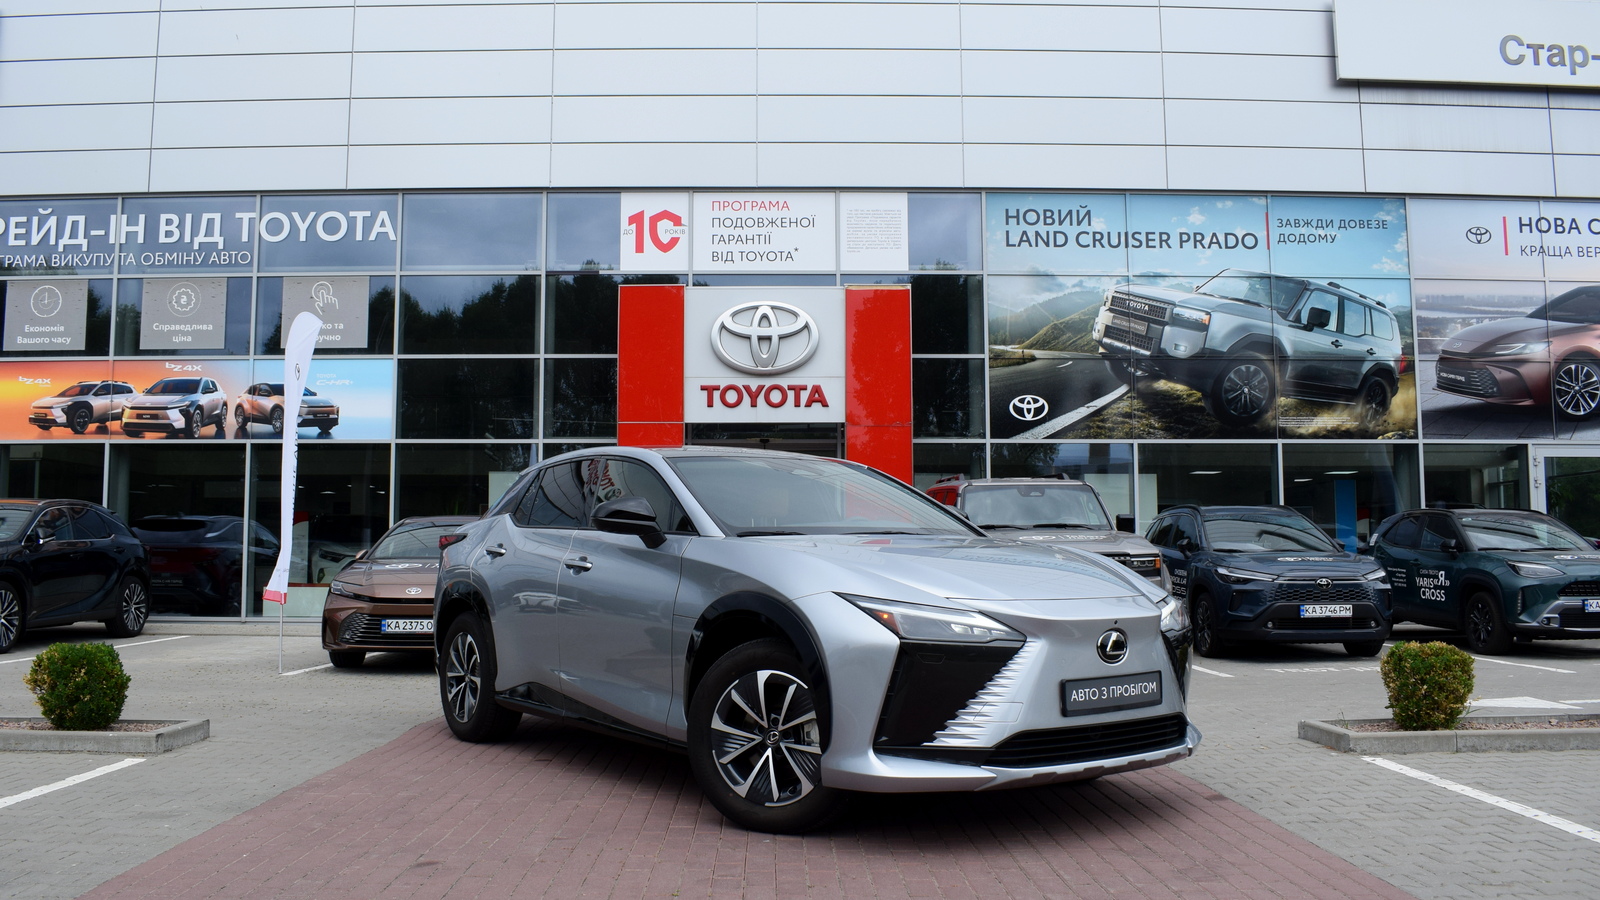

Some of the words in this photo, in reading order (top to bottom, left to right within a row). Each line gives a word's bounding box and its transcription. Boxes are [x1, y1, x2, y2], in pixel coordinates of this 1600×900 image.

[1499, 34, 1600, 76] Стар-
[711, 200, 790, 212] ПРОГРАМА
[711, 214, 816, 230] ПОДОВЖЕНОЇ
[1005, 204, 1091, 227] НОВИЙ
[159, 213, 224, 250] ВІД
[235, 210, 397, 243] TOYOTA
[1277, 218, 1334, 231] ЗАВЖДИ
[1338, 219, 1388, 231] ДОВЕЗЕ
[1518, 216, 1582, 235] НОВА
[711, 231, 772, 245] ГАРАНТІЇ
[1005, 230, 1069, 248] LAND
[1075, 231, 1172, 249] CRUISER
[1179, 232, 1259, 250] PRADO
[1277, 233, 1337, 245] ДОДОМУ
[51, 253, 115, 267] ВИКУПУ
[119, 252, 137, 266] ТА
[140, 251, 205, 266] ОБМІНУ
[208, 250, 252, 265] АВТО
[711, 251, 734, 264] ВІД
[1520, 245, 1573, 260] КРАЩА
[1577, 246, 1600, 258] ВЕР
[1126, 301, 1148, 310] TOYOTA
[24, 324, 65, 332] Економія
[152, 322, 213, 332] Справедлива
[17, 335, 50, 344] Вашого
[51, 336, 72, 345] часу
[172, 334, 192, 343] ціна
[700, 384, 830, 408] TOYOTA
[1415, 577, 1433, 588] YARIS
[1420, 588, 1445, 601] CROSS
[1304, 606, 1318, 615] KA
[1319, 606, 1338, 615] 3746
[1339, 605, 1352, 615] PM
[386, 621, 401, 631] KA
[402, 621, 425, 631] 2375
[1070, 688, 1099, 702] АВТО
[1101, 687, 1108, 699] З
[1109, 681, 1157, 698] ПРОБІГОМ
